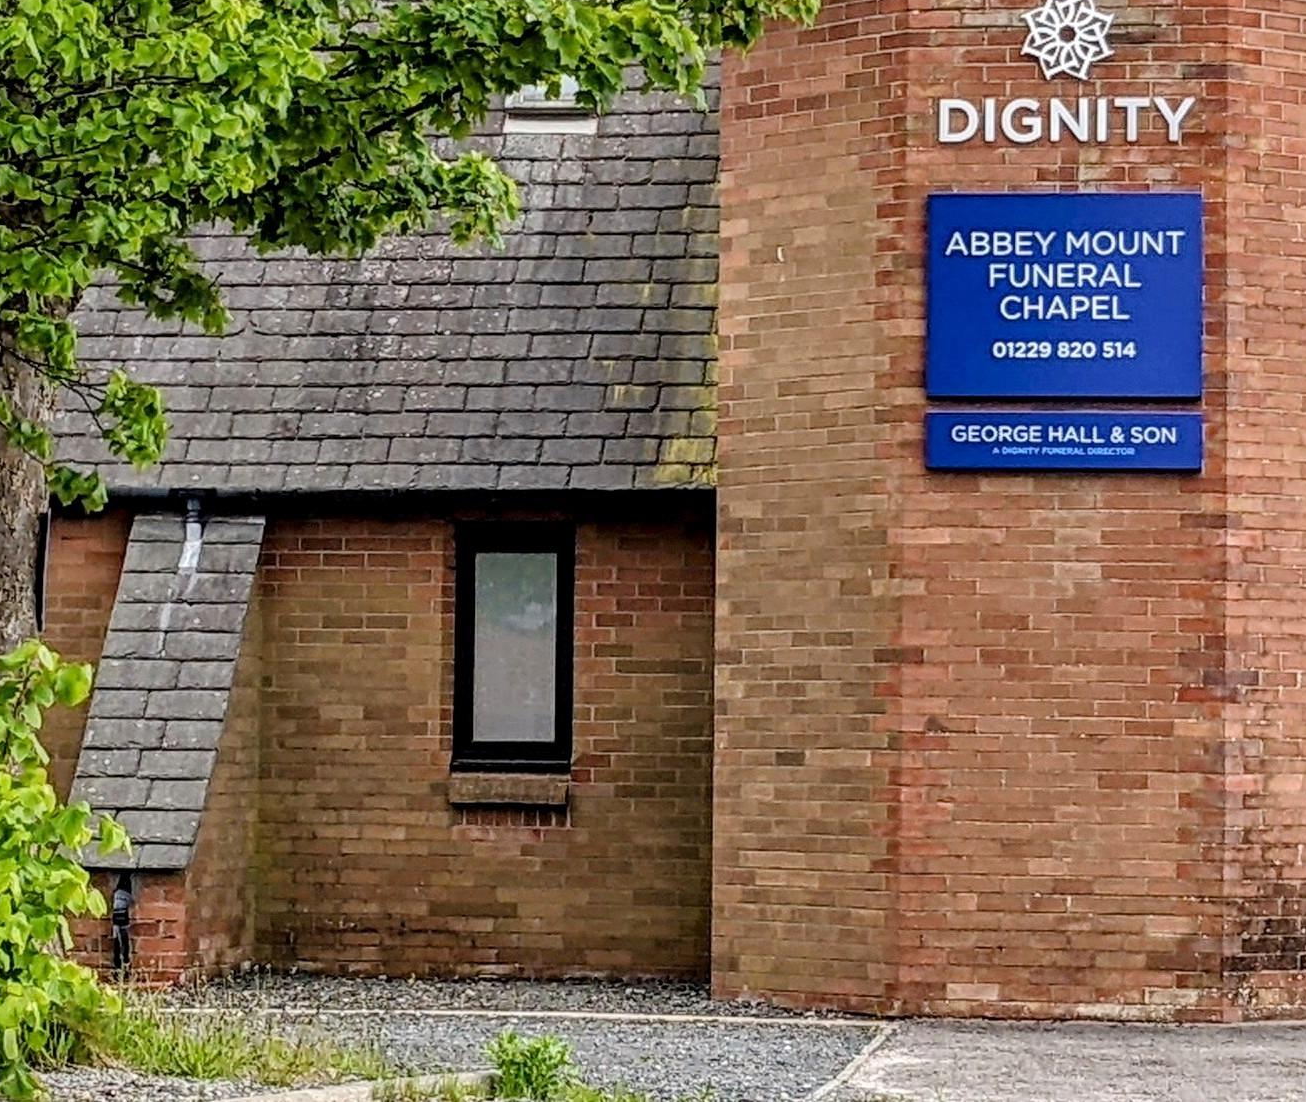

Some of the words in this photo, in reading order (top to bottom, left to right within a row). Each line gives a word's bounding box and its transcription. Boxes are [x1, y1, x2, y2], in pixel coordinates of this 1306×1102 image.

[938, 96, 1196, 143] DIGNITY
[945, 231, 1056, 256] ABBEY
[1065, 231, 1185, 256] MOUNT
[988, 263, 1142, 288] FUNERAL
[999, 295, 1131, 320] CHAPEL
[992, 341, 1051, 359] 01229
[1057, 341, 1096, 359] 820
[1102, 341, 1137, 359] 514
[951, 425, 1042, 443] GEORGE
[1049, 426, 1105, 443] HALL
[1110, 426, 1125, 443] &
[1130, 427, 1176, 444] SON
[1002, 447, 1040, 455] DIGNITY
[1042, 447, 1085, 456] FUNERAL
[1088, 447, 1135, 456] DIRECTOR
